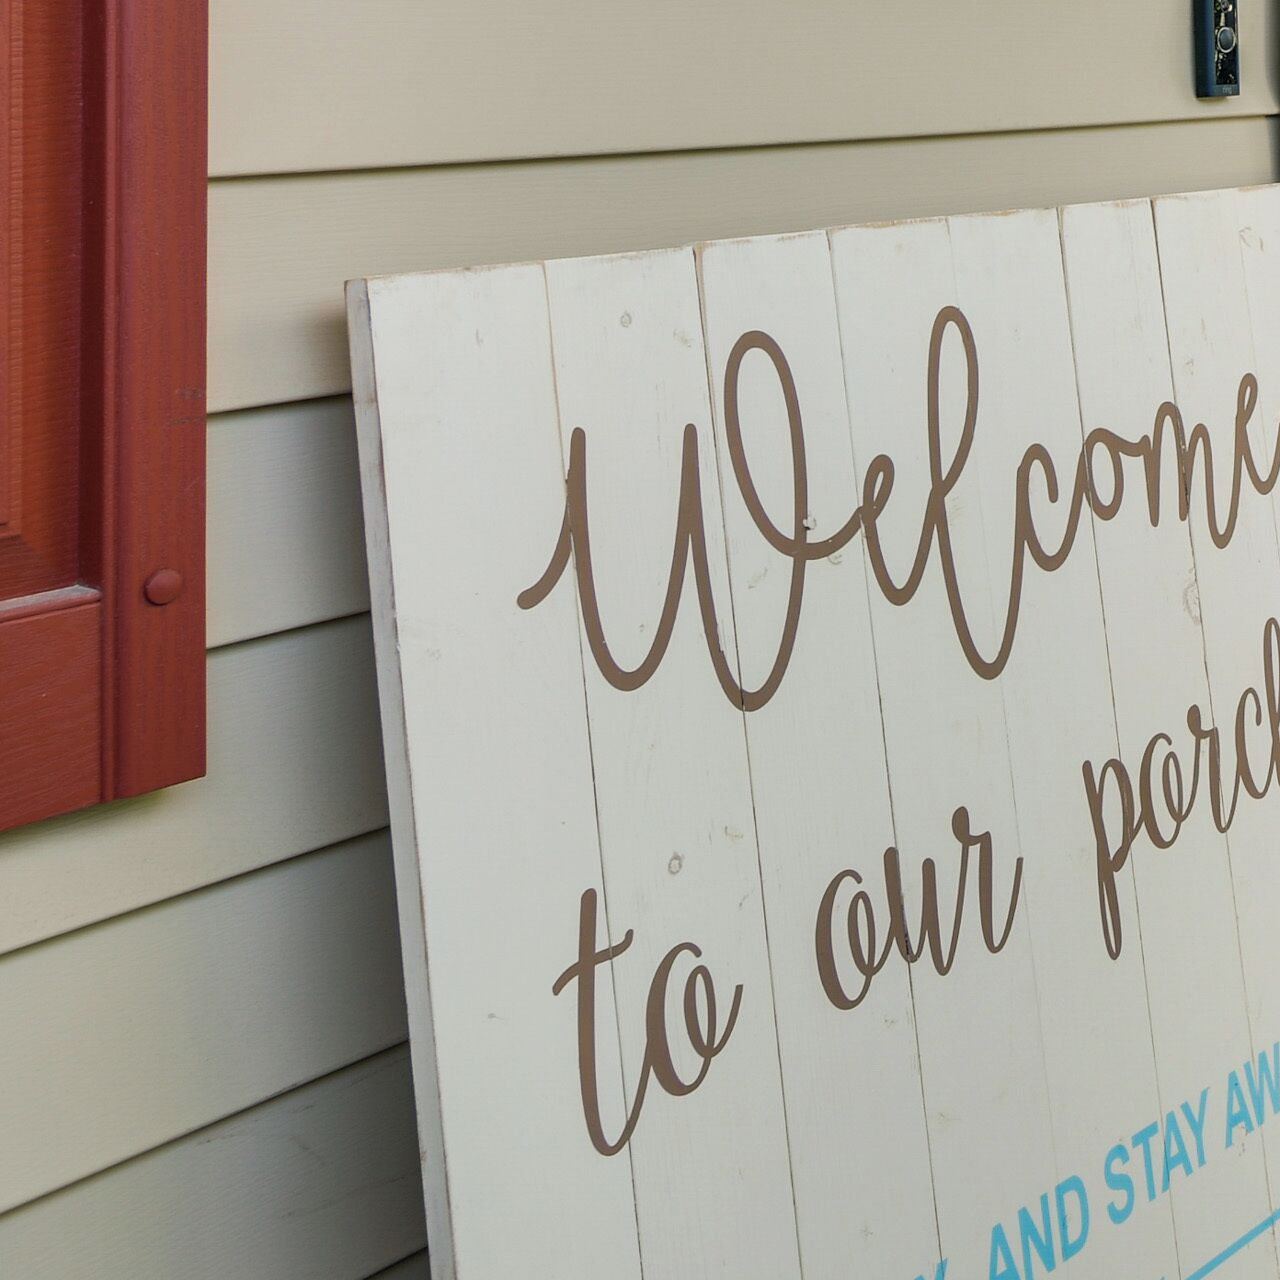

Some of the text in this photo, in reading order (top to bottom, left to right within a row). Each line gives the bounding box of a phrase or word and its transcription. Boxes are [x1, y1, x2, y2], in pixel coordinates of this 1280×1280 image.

[552, 888, 743, 1157] to
[814, 805, 1024, 1011] our
[987, 1174, 1091, 1280] AND
[1103, 1086, 1210, 1225] STAY
